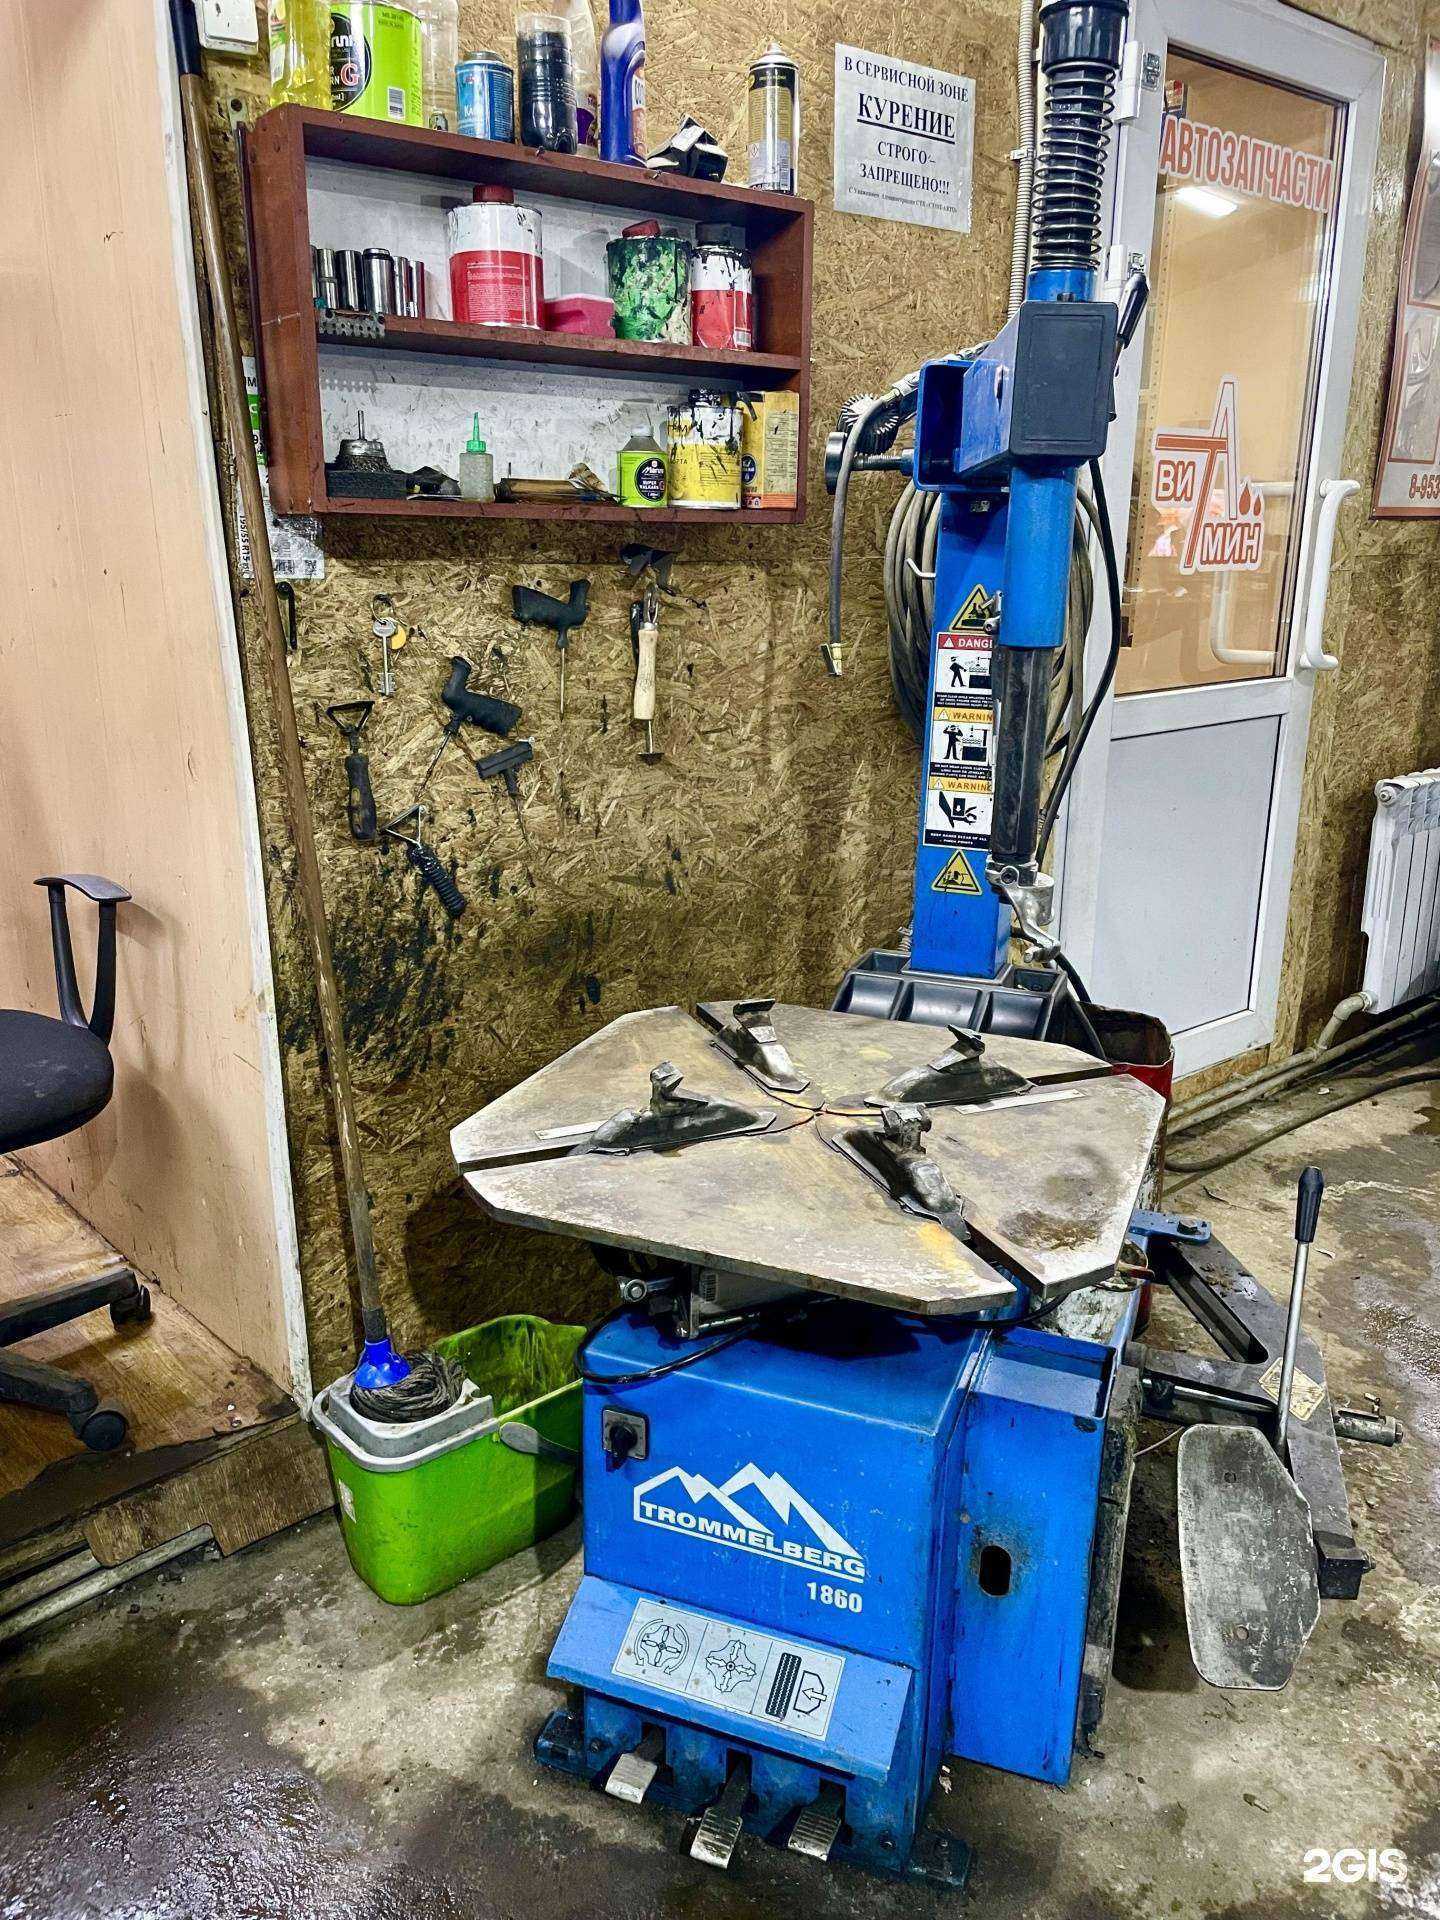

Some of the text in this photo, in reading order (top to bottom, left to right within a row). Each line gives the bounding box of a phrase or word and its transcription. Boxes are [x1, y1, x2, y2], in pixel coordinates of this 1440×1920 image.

[844, 56, 969, 102] В СЕРВИСНОЙ ЗОНЕ
[858, 92, 955, 139] КУРЕНИЕ
[860, 163, 950, 195] ЗАПРЕЩЕНО!!!
[1160, 119, 1332, 210] АВТОЗАПЧАСТИ
[1408, 473, 1440, 500] 8-953
[958, 638, 992, 649] DANG
[953, 712, 992, 721] WARNIN
[640, 1501, 865, 1577] TROMMELBERG
[806, 1582, 863, 1613] 1860
